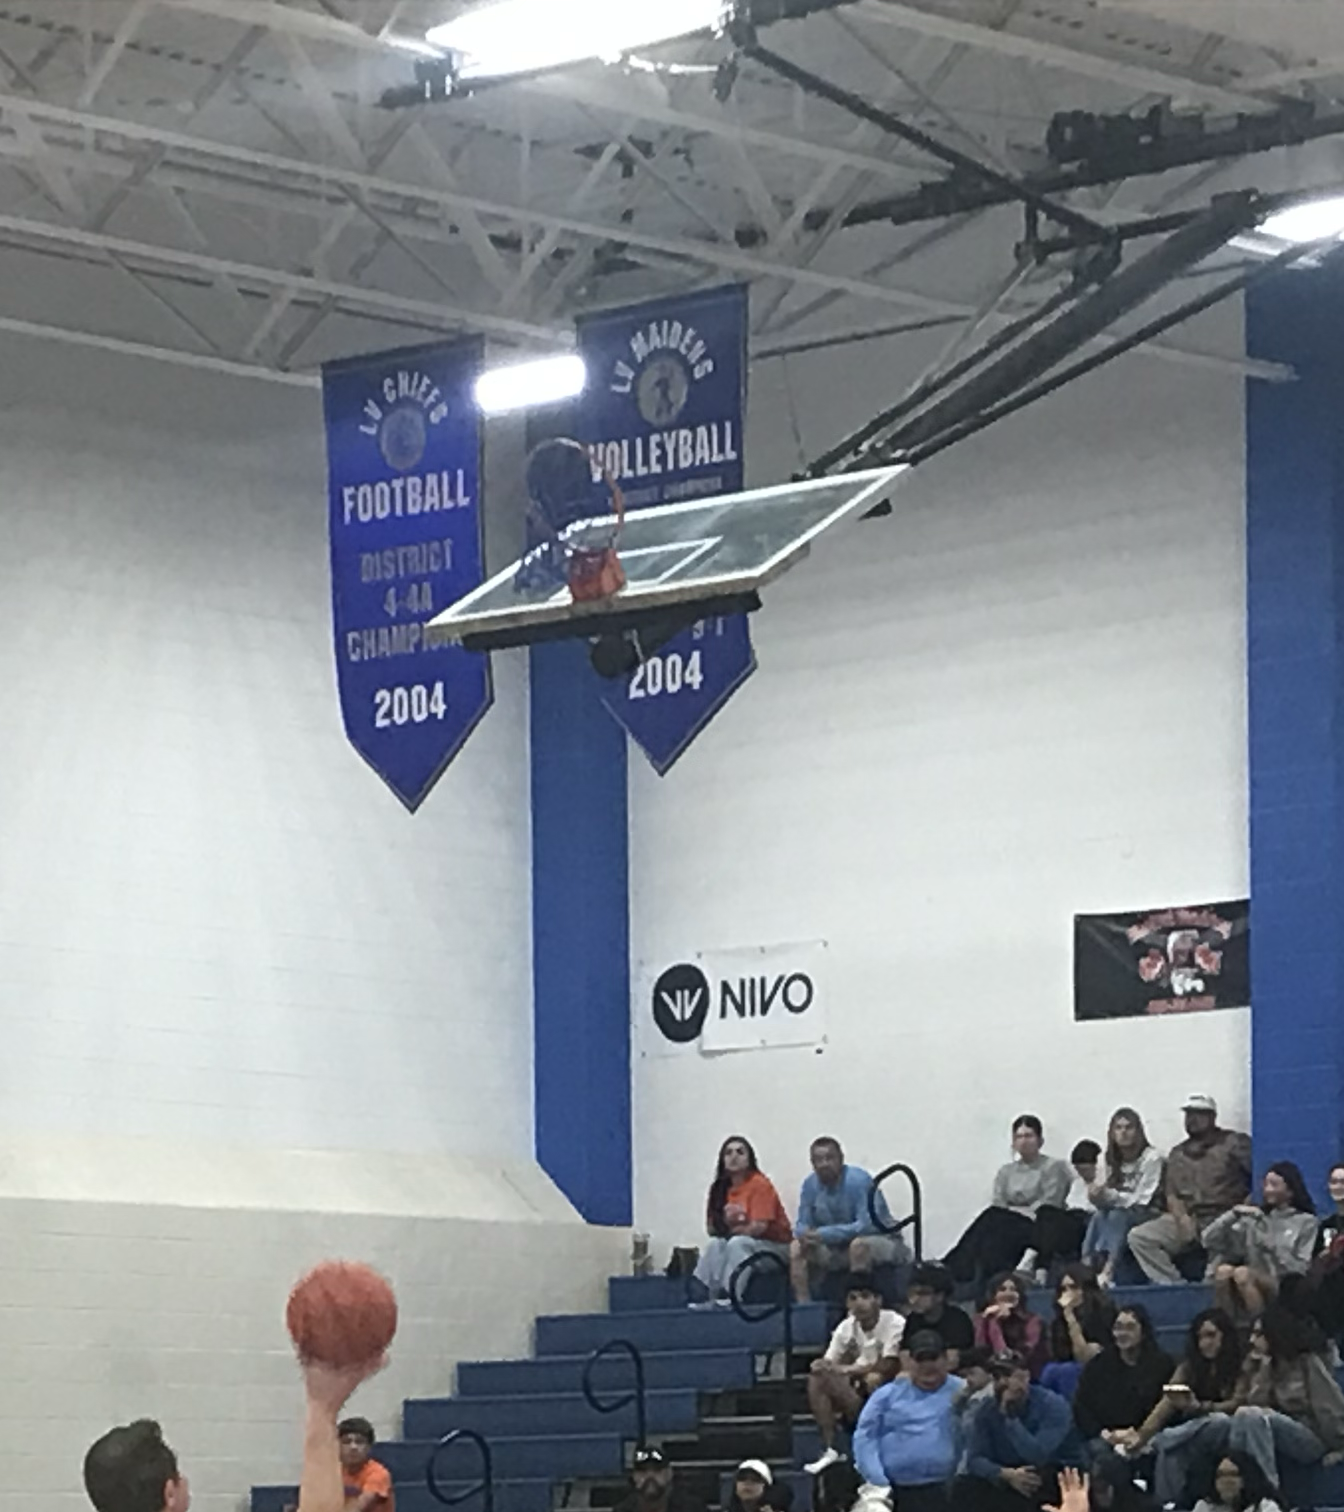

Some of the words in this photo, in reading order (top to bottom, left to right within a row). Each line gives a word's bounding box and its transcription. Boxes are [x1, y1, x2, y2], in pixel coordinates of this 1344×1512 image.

[630, 319, 714, 380] MAIDENS
[383, 371, 448, 424] CHIEFS
[588, 420, 737, 484] VOLLEYBALL
[343, 468, 470, 525] FOOTBALL
[360, 538, 453, 583] DISTRICT
[383, 582, 433, 617] 4-4A
[629, 650, 703, 700] 2004
[374, 680, 447, 728] 2004
[719, 972, 813, 1019] NIVO
